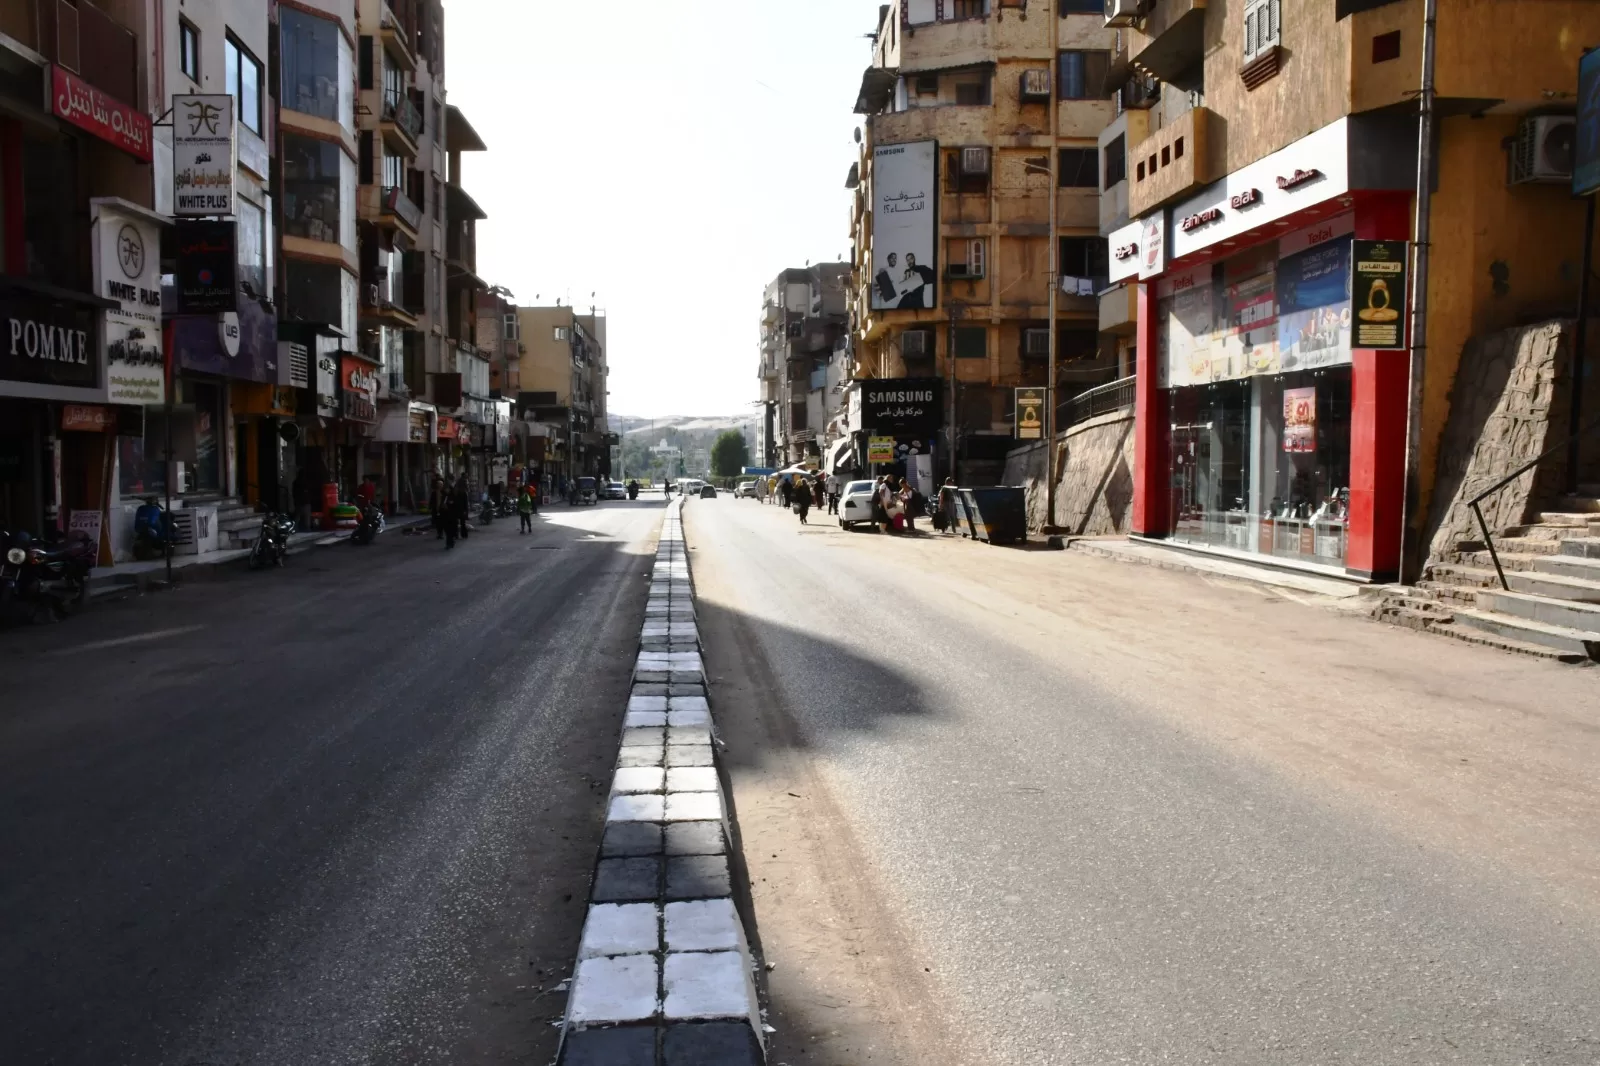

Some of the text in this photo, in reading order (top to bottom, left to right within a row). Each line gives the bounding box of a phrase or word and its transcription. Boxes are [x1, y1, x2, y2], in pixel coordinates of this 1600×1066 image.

[875, 147, 905, 156] SAMSUNG
[179, 195, 227, 208] WHITE PLUS
[1307, 226, 1334, 245] Tefal
[1174, 274, 1194, 290] Tefal
[108, 279, 137, 302] WHITE
[140, 287, 160, 307] PLUS
[8, 318, 88, 365] POMME
[868, 390, 933, 404] SAMSUNG
[876, 406, 923, 417] شركة وان بلس
